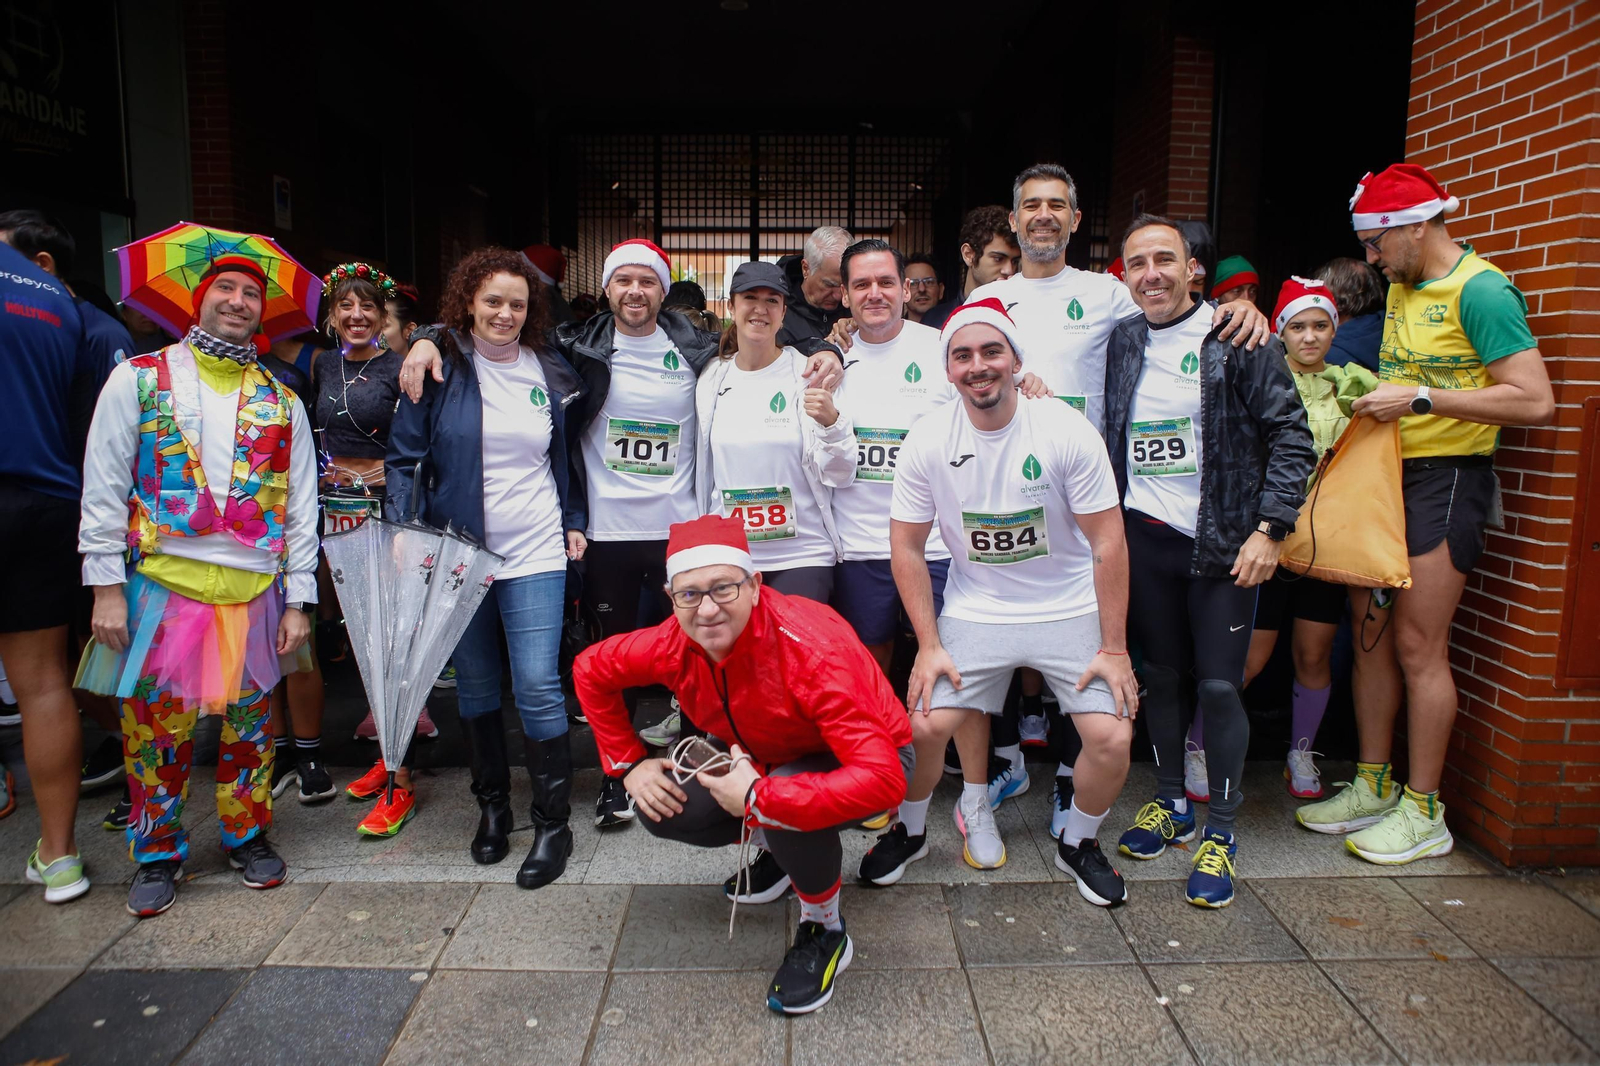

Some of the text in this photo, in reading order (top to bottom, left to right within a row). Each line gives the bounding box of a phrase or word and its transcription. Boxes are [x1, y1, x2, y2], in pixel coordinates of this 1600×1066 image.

[0, 80, 88, 138] ARIDAJE
[1063, 323, 1090, 331] alvarez
[660, 371, 685, 381] alvarez
[899, 385, 927, 394] alvarez
[764, 415, 790, 424] alvarez
[614, 437, 669, 462] 101
[1133, 438, 1186, 463] 529
[1020, 483, 1051, 494] alvarez
[970, 526, 1038, 551] 684
